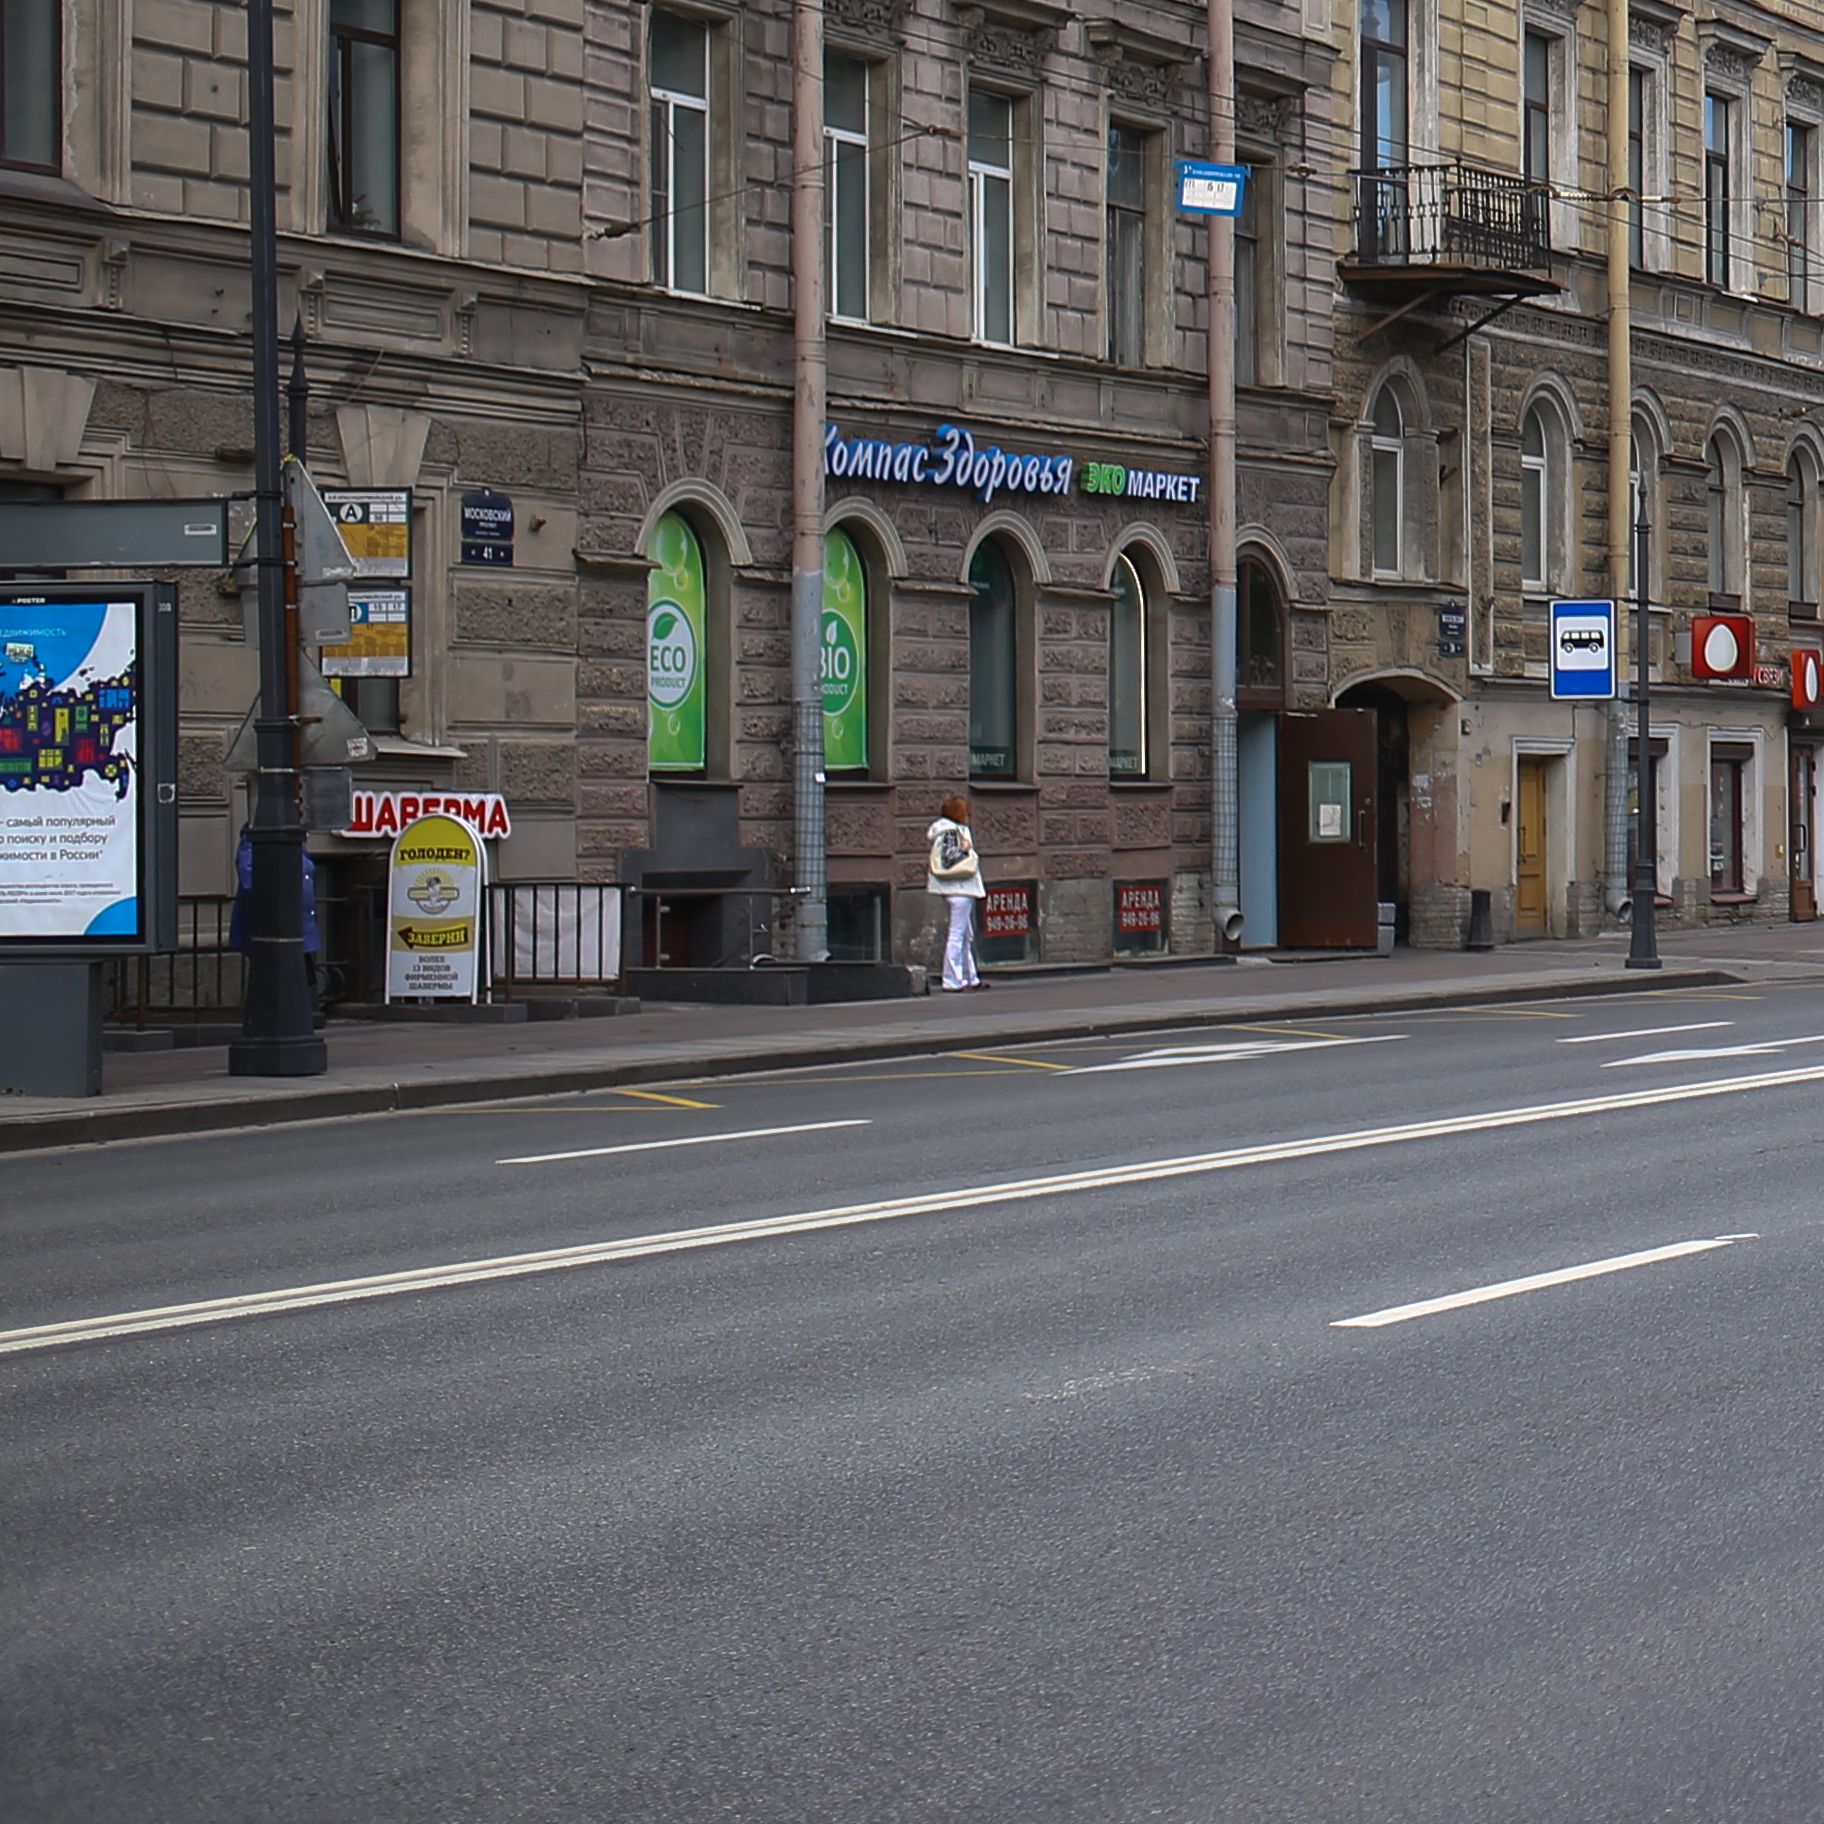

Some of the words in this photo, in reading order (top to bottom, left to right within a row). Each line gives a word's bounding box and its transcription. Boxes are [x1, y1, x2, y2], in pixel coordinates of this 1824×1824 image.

[934, 427, 1073, 503] Здоровья
[482, 546, 493, 560] 41
[649, 645, 687, 673] ECO
[650, 677, 686, 688] PRODUCT
[6, 816, 44, 827] самый
[46, 815, 116, 829] популярный
[7, 834, 46, 845] поиску
[59, 832, 108, 845] подбору
[400, 847, 471, 862] ГОЛОДЕН?
[986, 892, 1029, 913] АРЕНДА
[1122, 890, 1161, 910] АРЕНДА
[407, 929, 466, 946] ЗАВЕРНИ
[404, 972, 459, 982] ФИРМЕННОЙ
[408, 982, 454, 991] ШАВЕРМЫ
